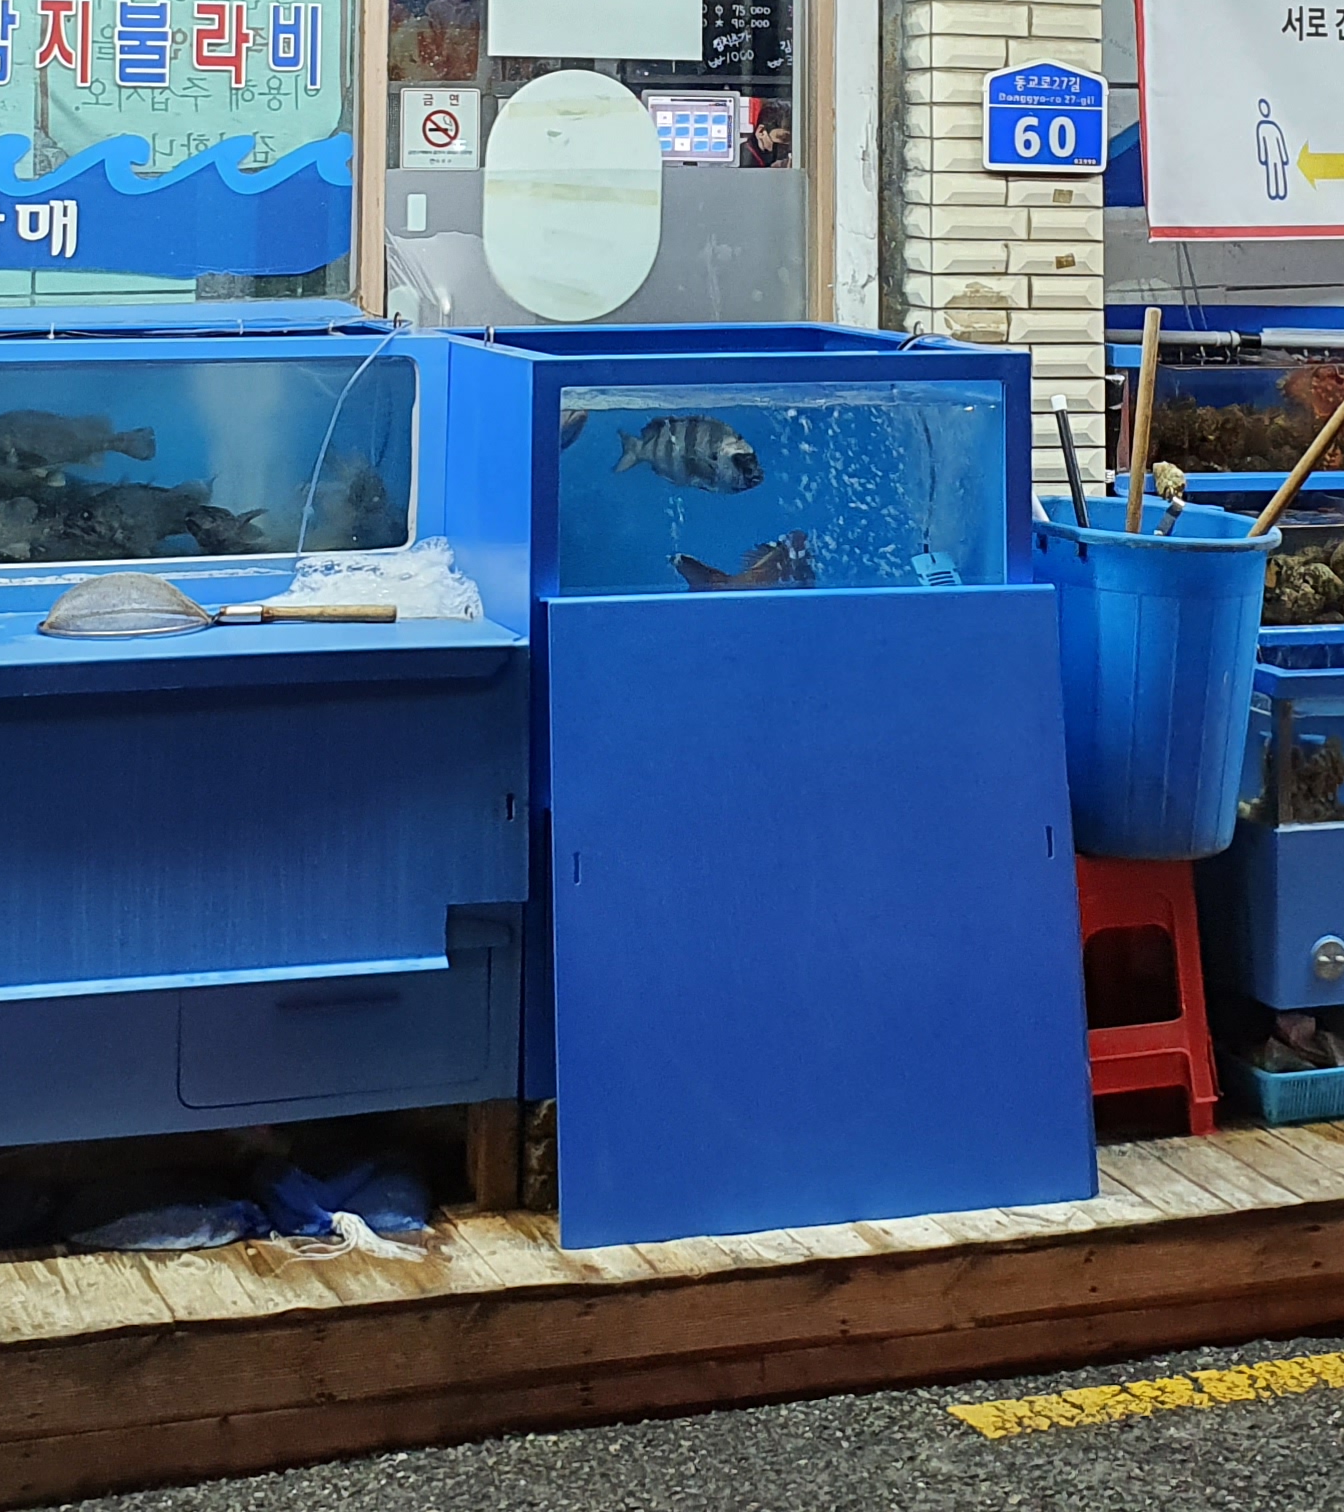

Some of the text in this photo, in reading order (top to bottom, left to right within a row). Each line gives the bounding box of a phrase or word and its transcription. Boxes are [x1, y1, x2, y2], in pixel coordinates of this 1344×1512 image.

[1281, 6, 1329, 42] 서로
[1013, 75, 1080, 93] 동교로27길
[998, 92, 1095, 106] Donggyo-ro 27-gil
[1014, 116, 1076, 158] 60
